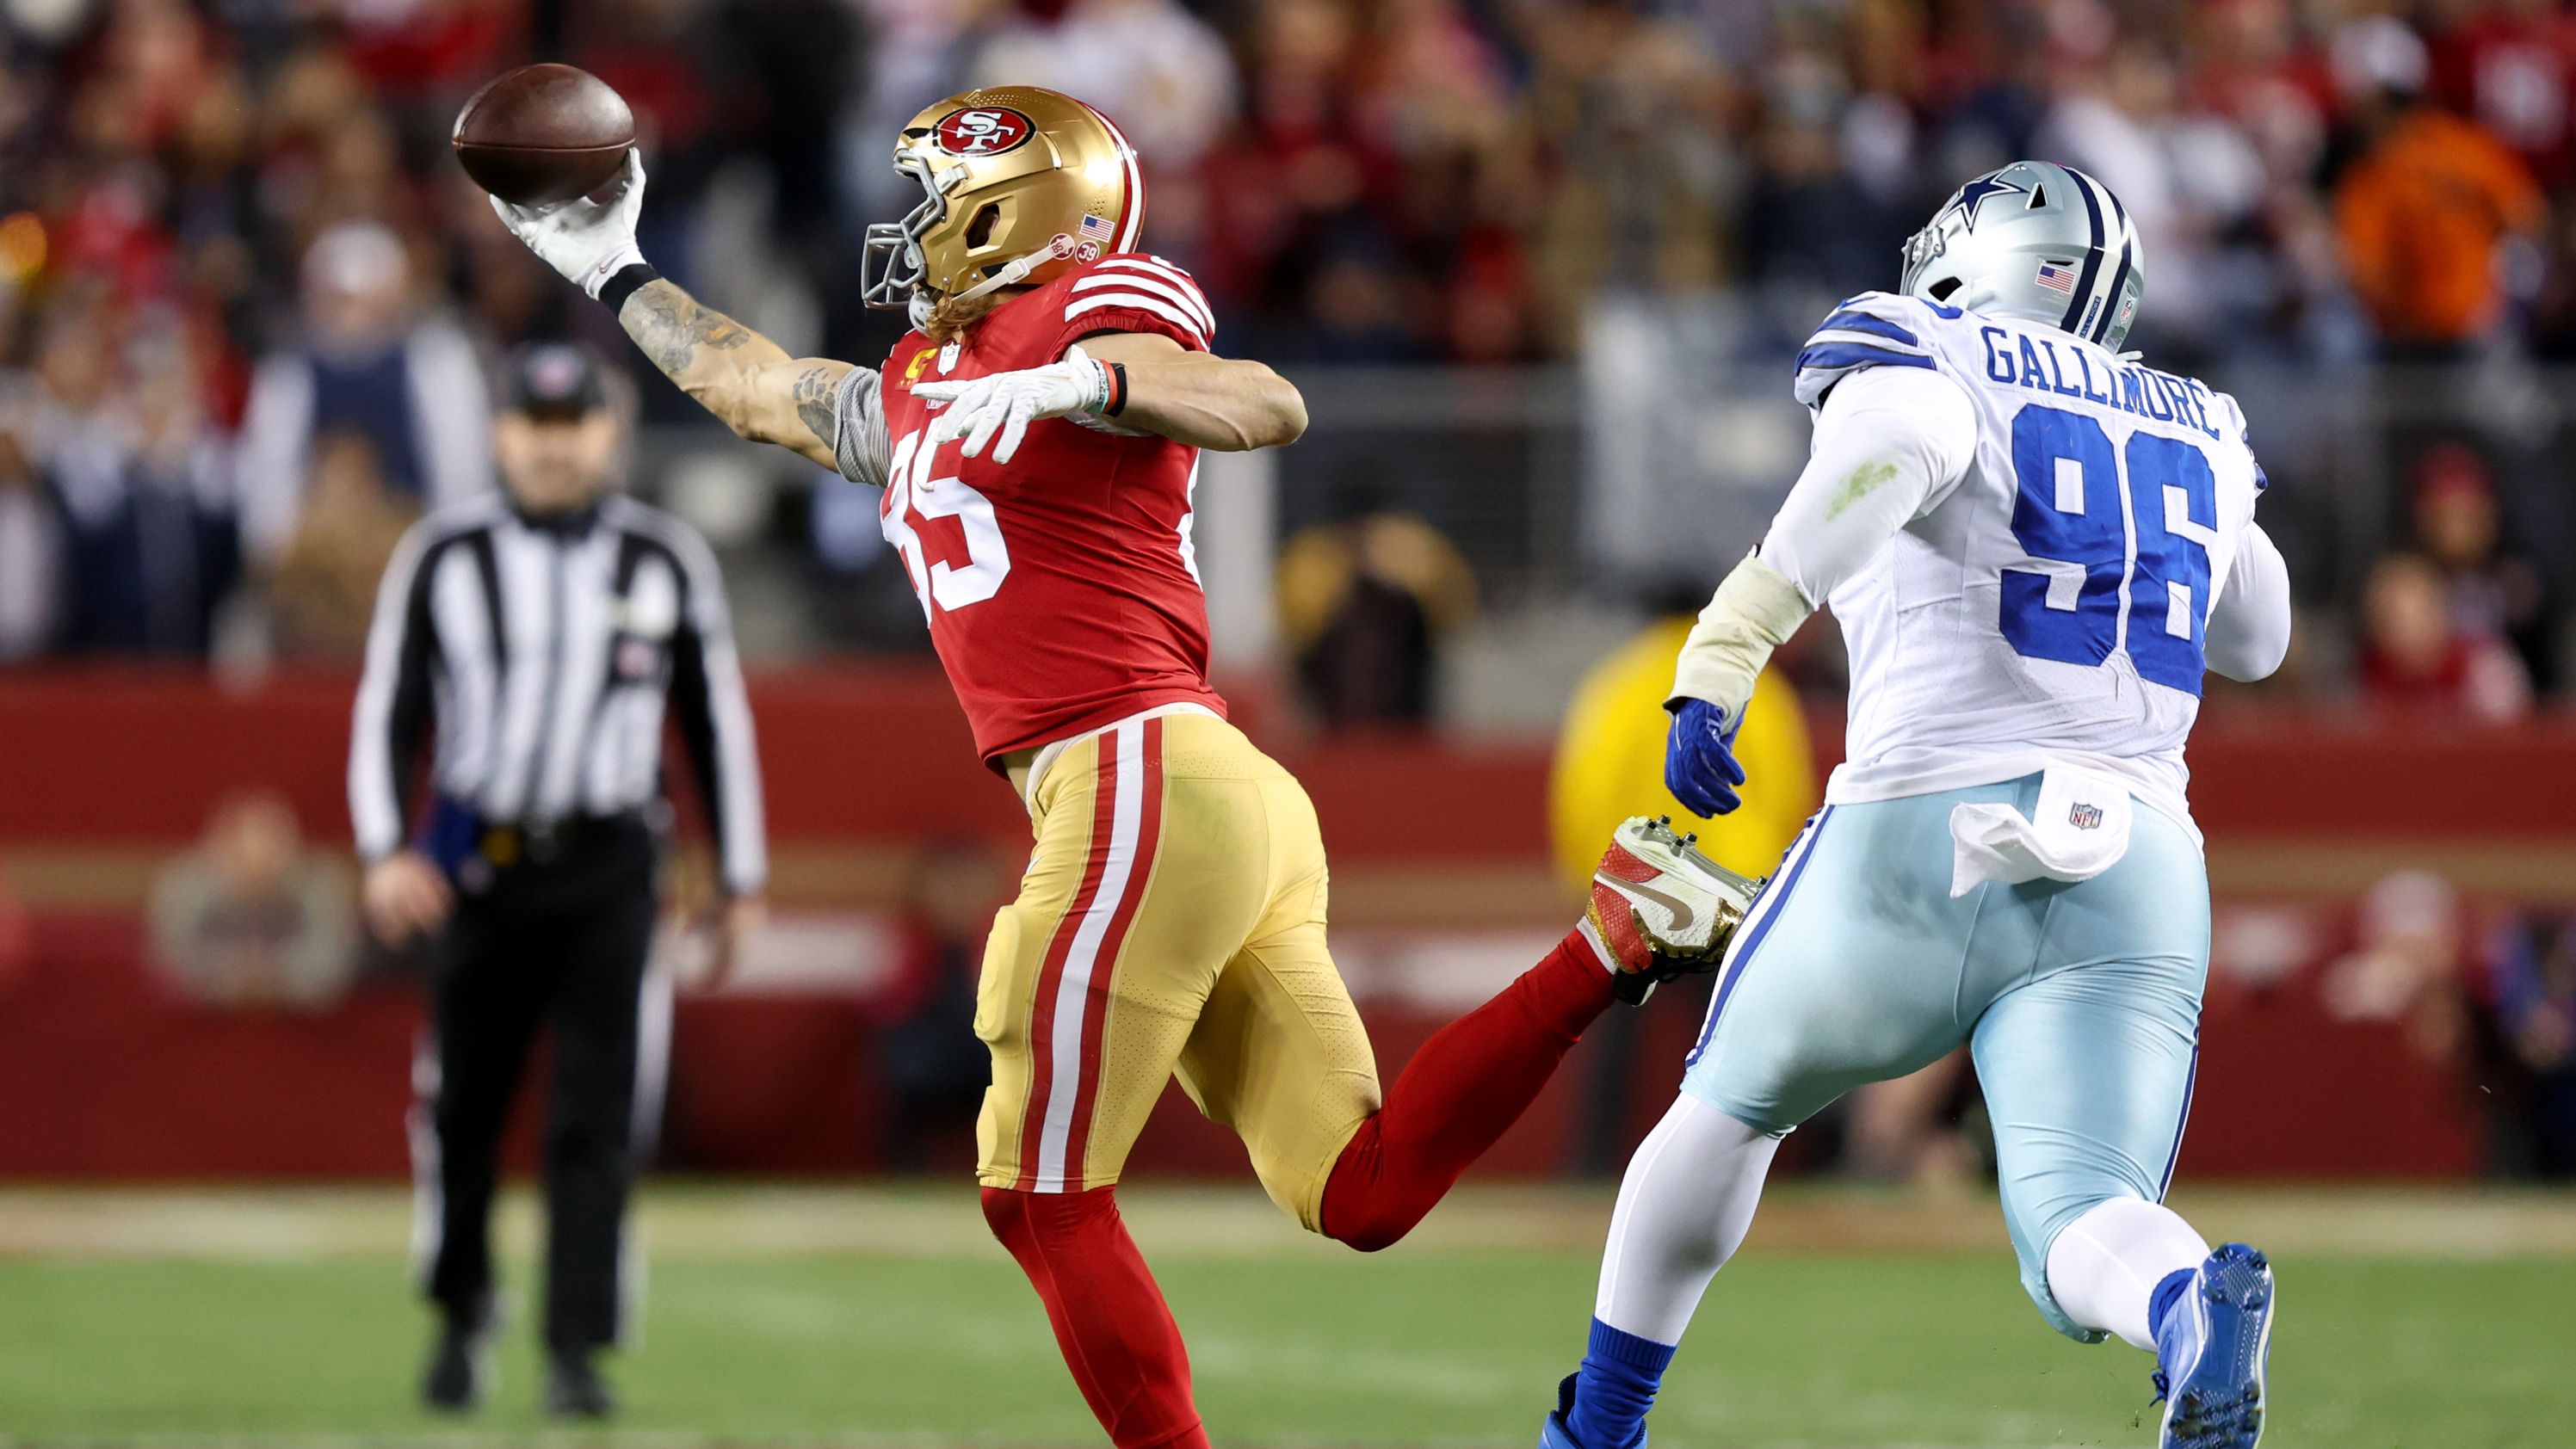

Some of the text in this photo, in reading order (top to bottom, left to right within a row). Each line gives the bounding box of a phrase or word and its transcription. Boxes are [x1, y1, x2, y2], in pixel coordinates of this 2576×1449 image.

[1051, 242, 1064, 254] 85
[1078, 244, 1097, 262] 39
[905, 348, 937, 379] C
[1981, 326, 2220, 441] GALLIMORE
[1998, 403, 2218, 700] 96
[2073, 811, 2099, 827] NFL
